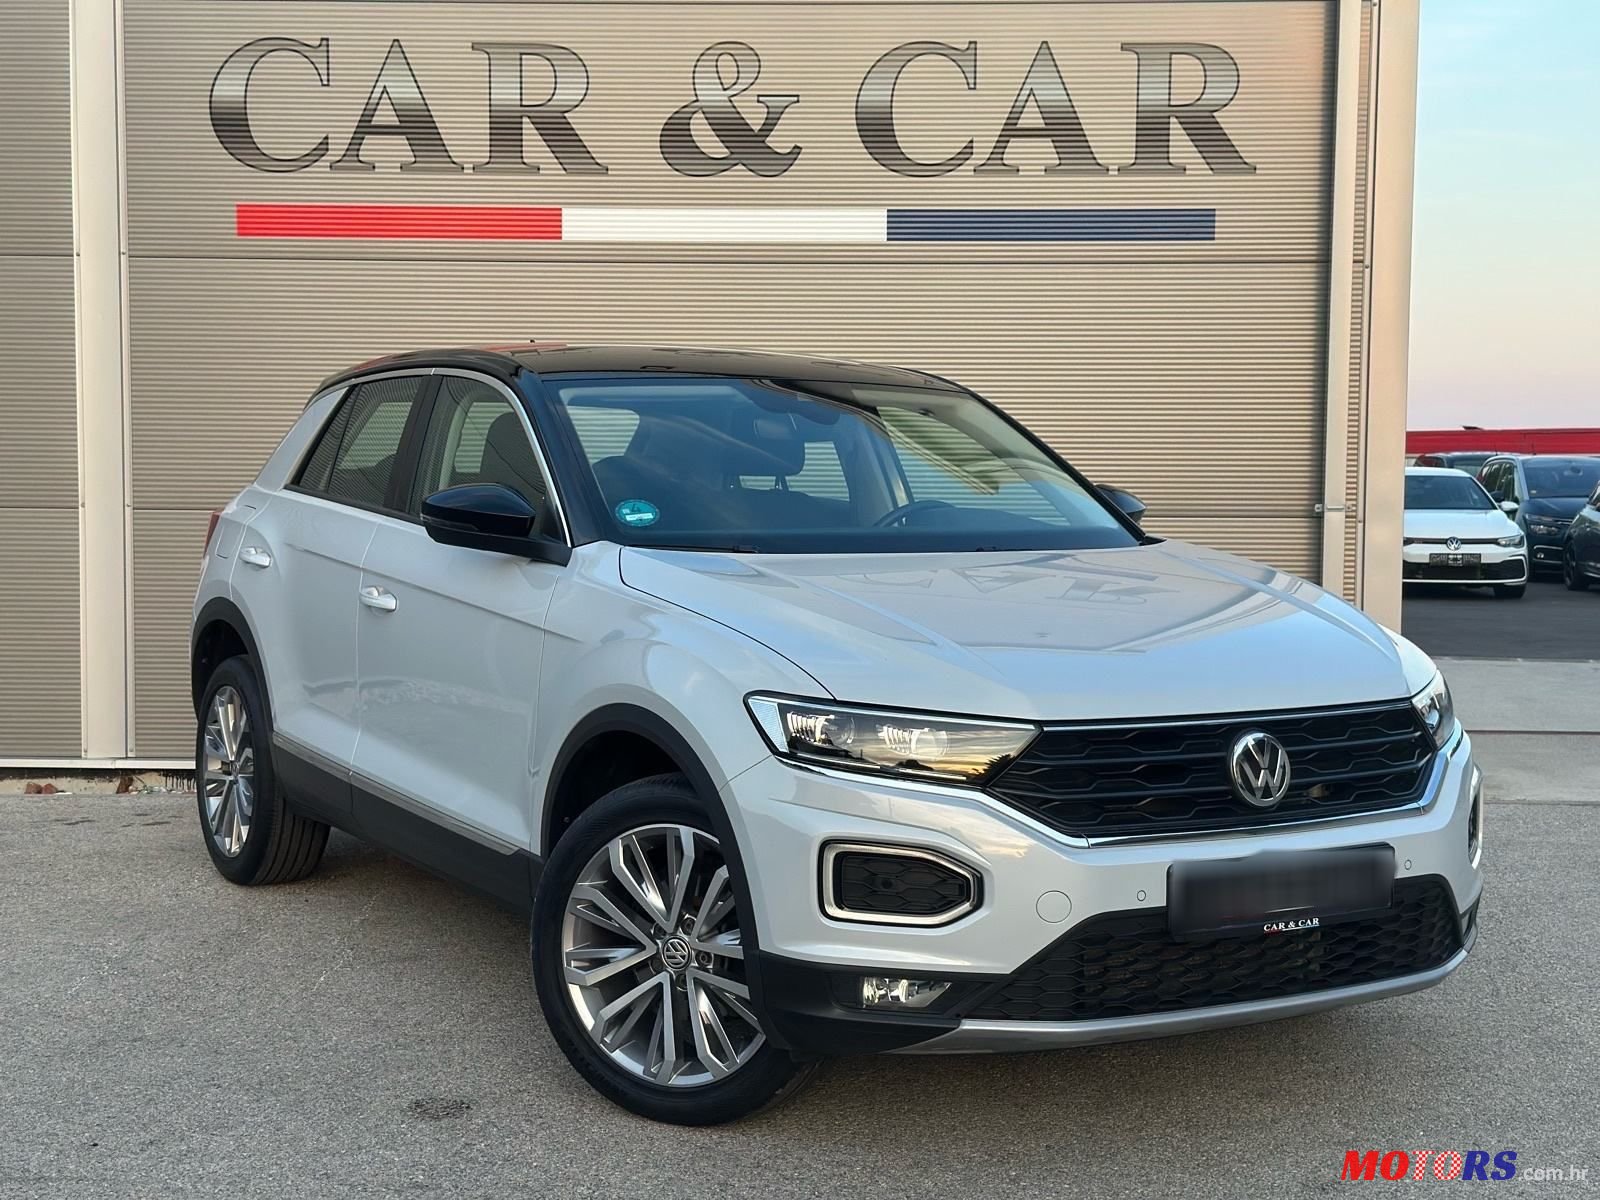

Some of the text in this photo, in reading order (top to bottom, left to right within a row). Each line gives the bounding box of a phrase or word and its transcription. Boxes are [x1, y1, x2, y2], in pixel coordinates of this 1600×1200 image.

[209, 37, 1257, 177] CAR & CAR
[1263, 917, 1319, 932] CAR & CAR
